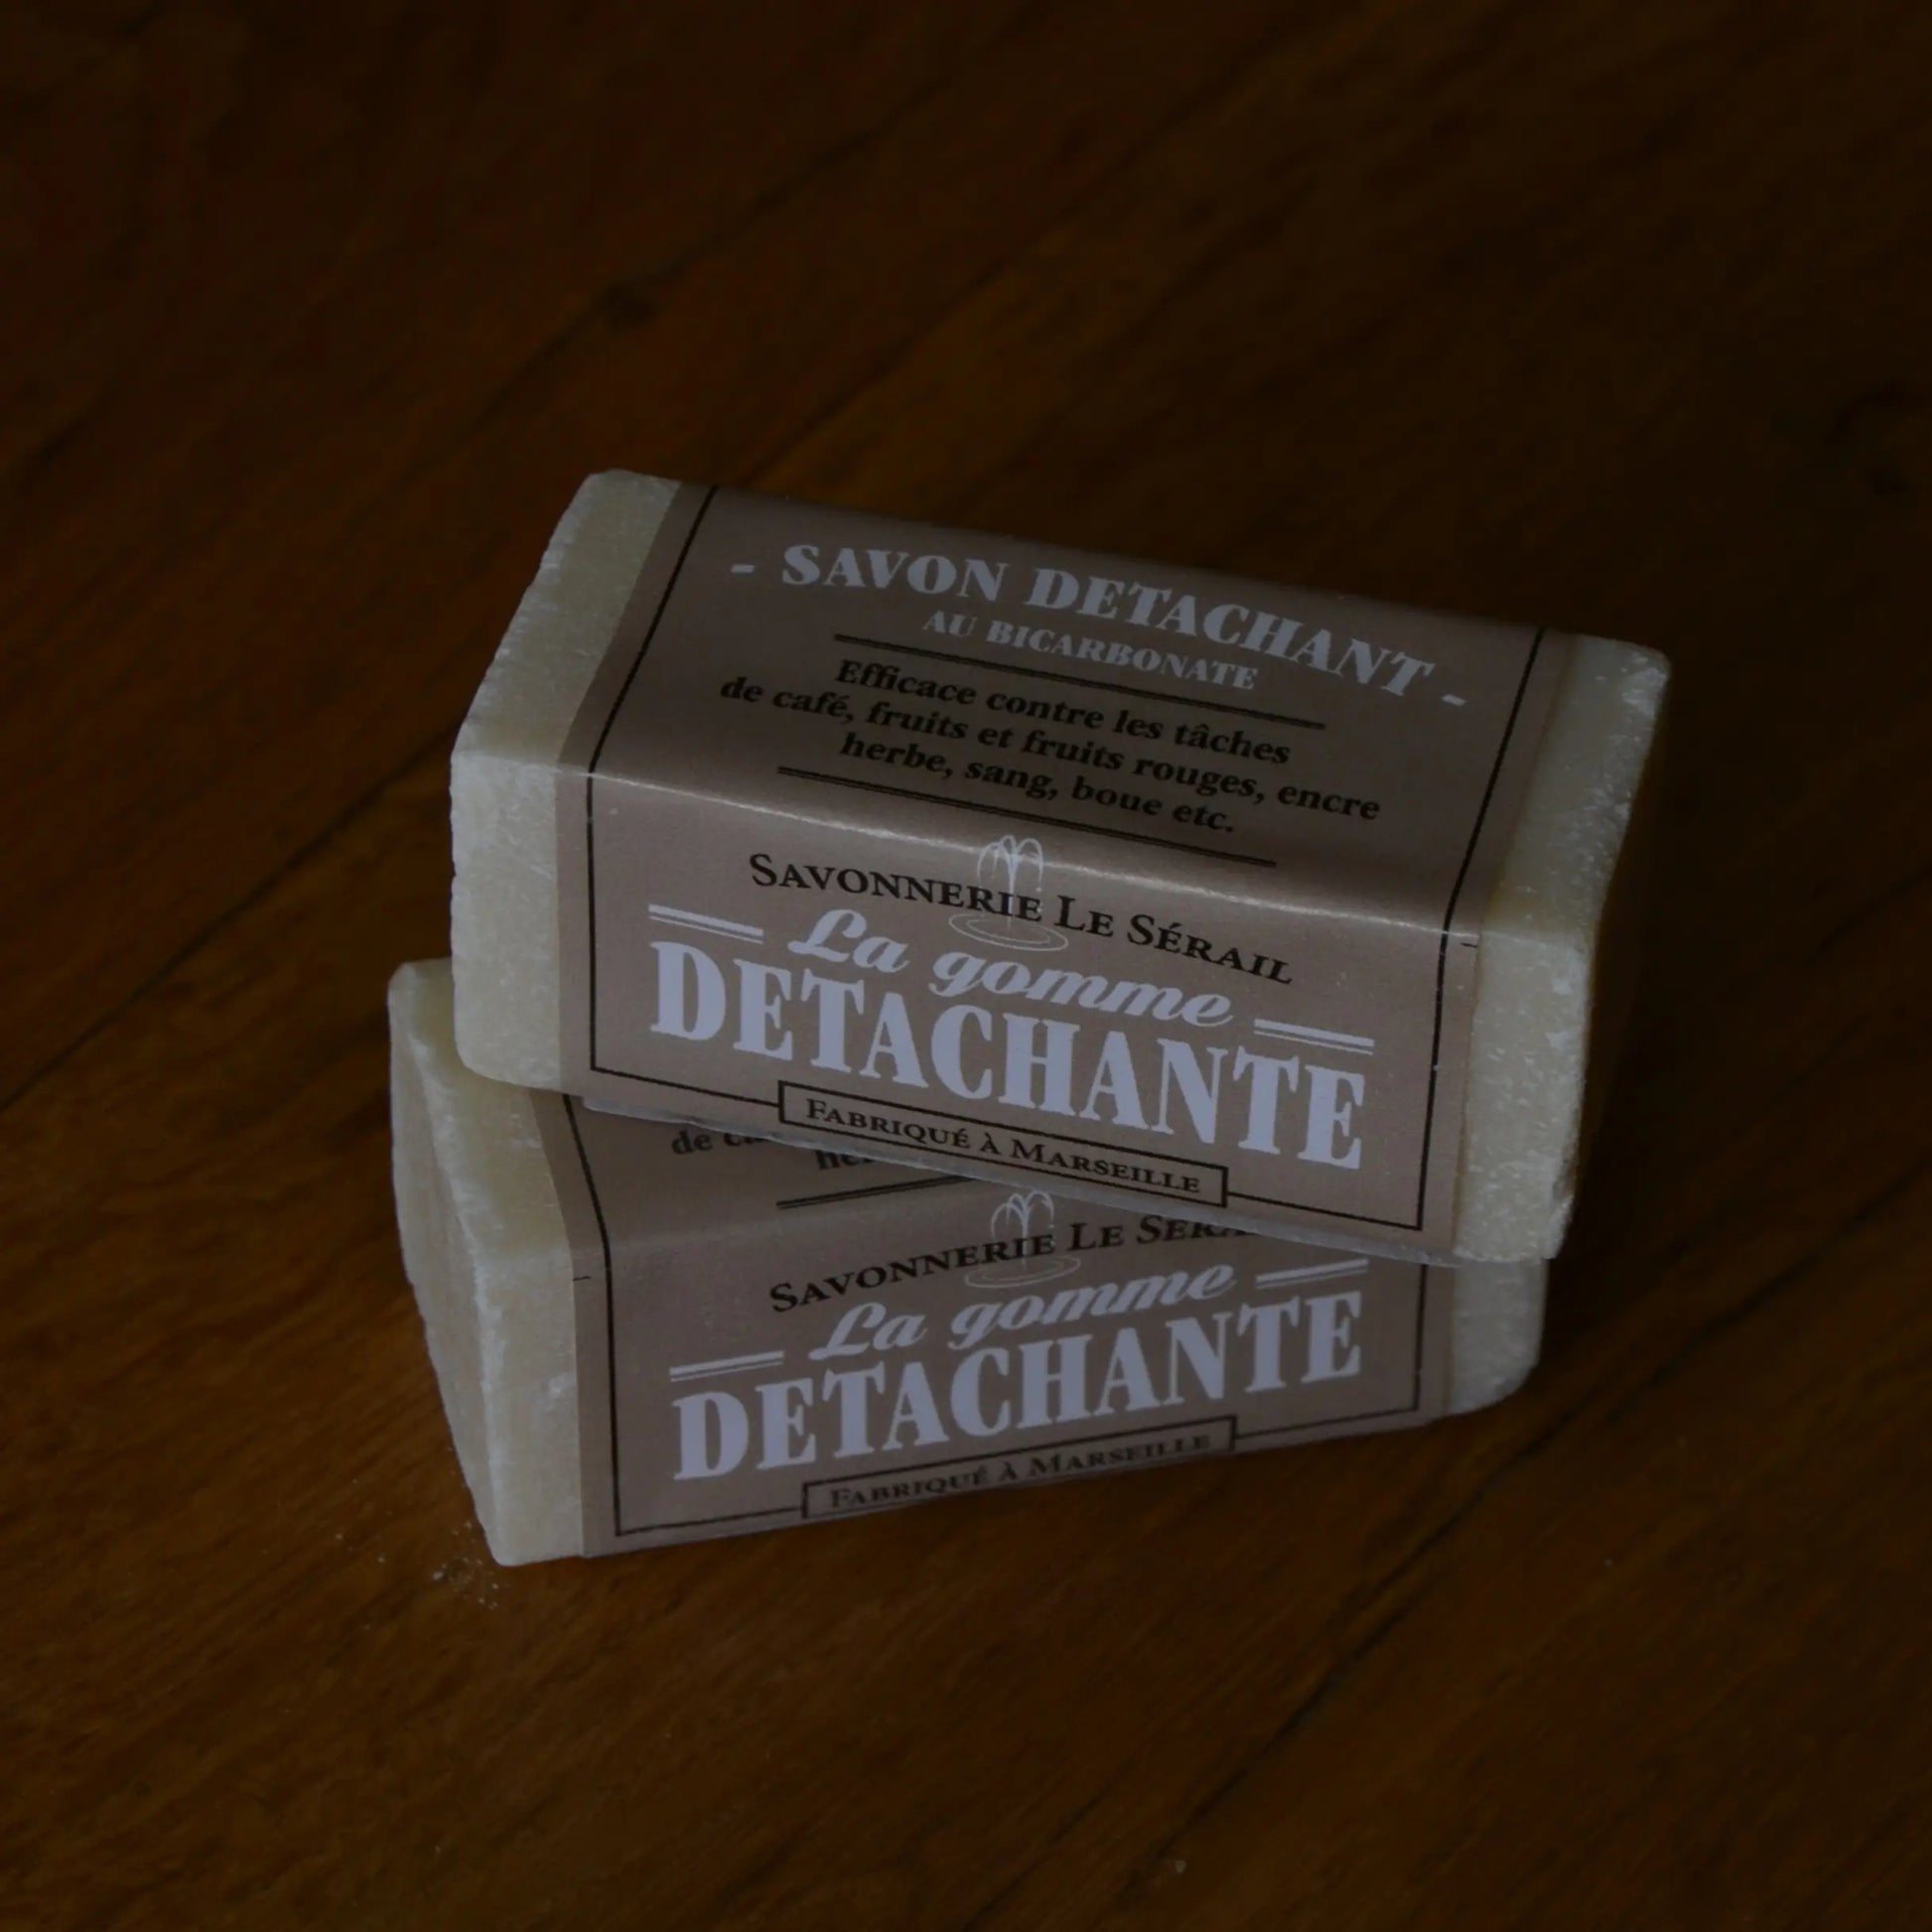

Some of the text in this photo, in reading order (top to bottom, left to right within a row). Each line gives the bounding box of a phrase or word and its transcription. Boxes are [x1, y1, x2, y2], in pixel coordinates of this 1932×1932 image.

[781, 545, 1010, 602] SAVON
[1025, 567, 1436, 697] DETACHANT
[923, 610, 1259, 690] AU BICARBONATE
[721, 677, 1381, 820] de café, fruits et fruits rouges, encre
[836, 659, 1292, 764] Efficace contre les tâches
[840, 733, 1235, 833] herbe, sang, boue etc.
[749, 854, 1293, 985] SAVONNERIE LE SÉRAIL
[787, 908, 1234, 1028] La gomme
[649, 940, 1366, 1171] DETACHANTE
[671, 1130, 713, 1156] de
[806, 1098, 975, 1148] FABRIQUÉ
[1012, 1139, 1200, 1193] MARSEILLE
[769, 1234, 1055, 1312] SAVONNERIE
[1068, 1222, 1124, 1252] LE
[808, 1264, 1237, 1361] La gomme
[672, 1292, 1362, 1480] DETACHANTE
